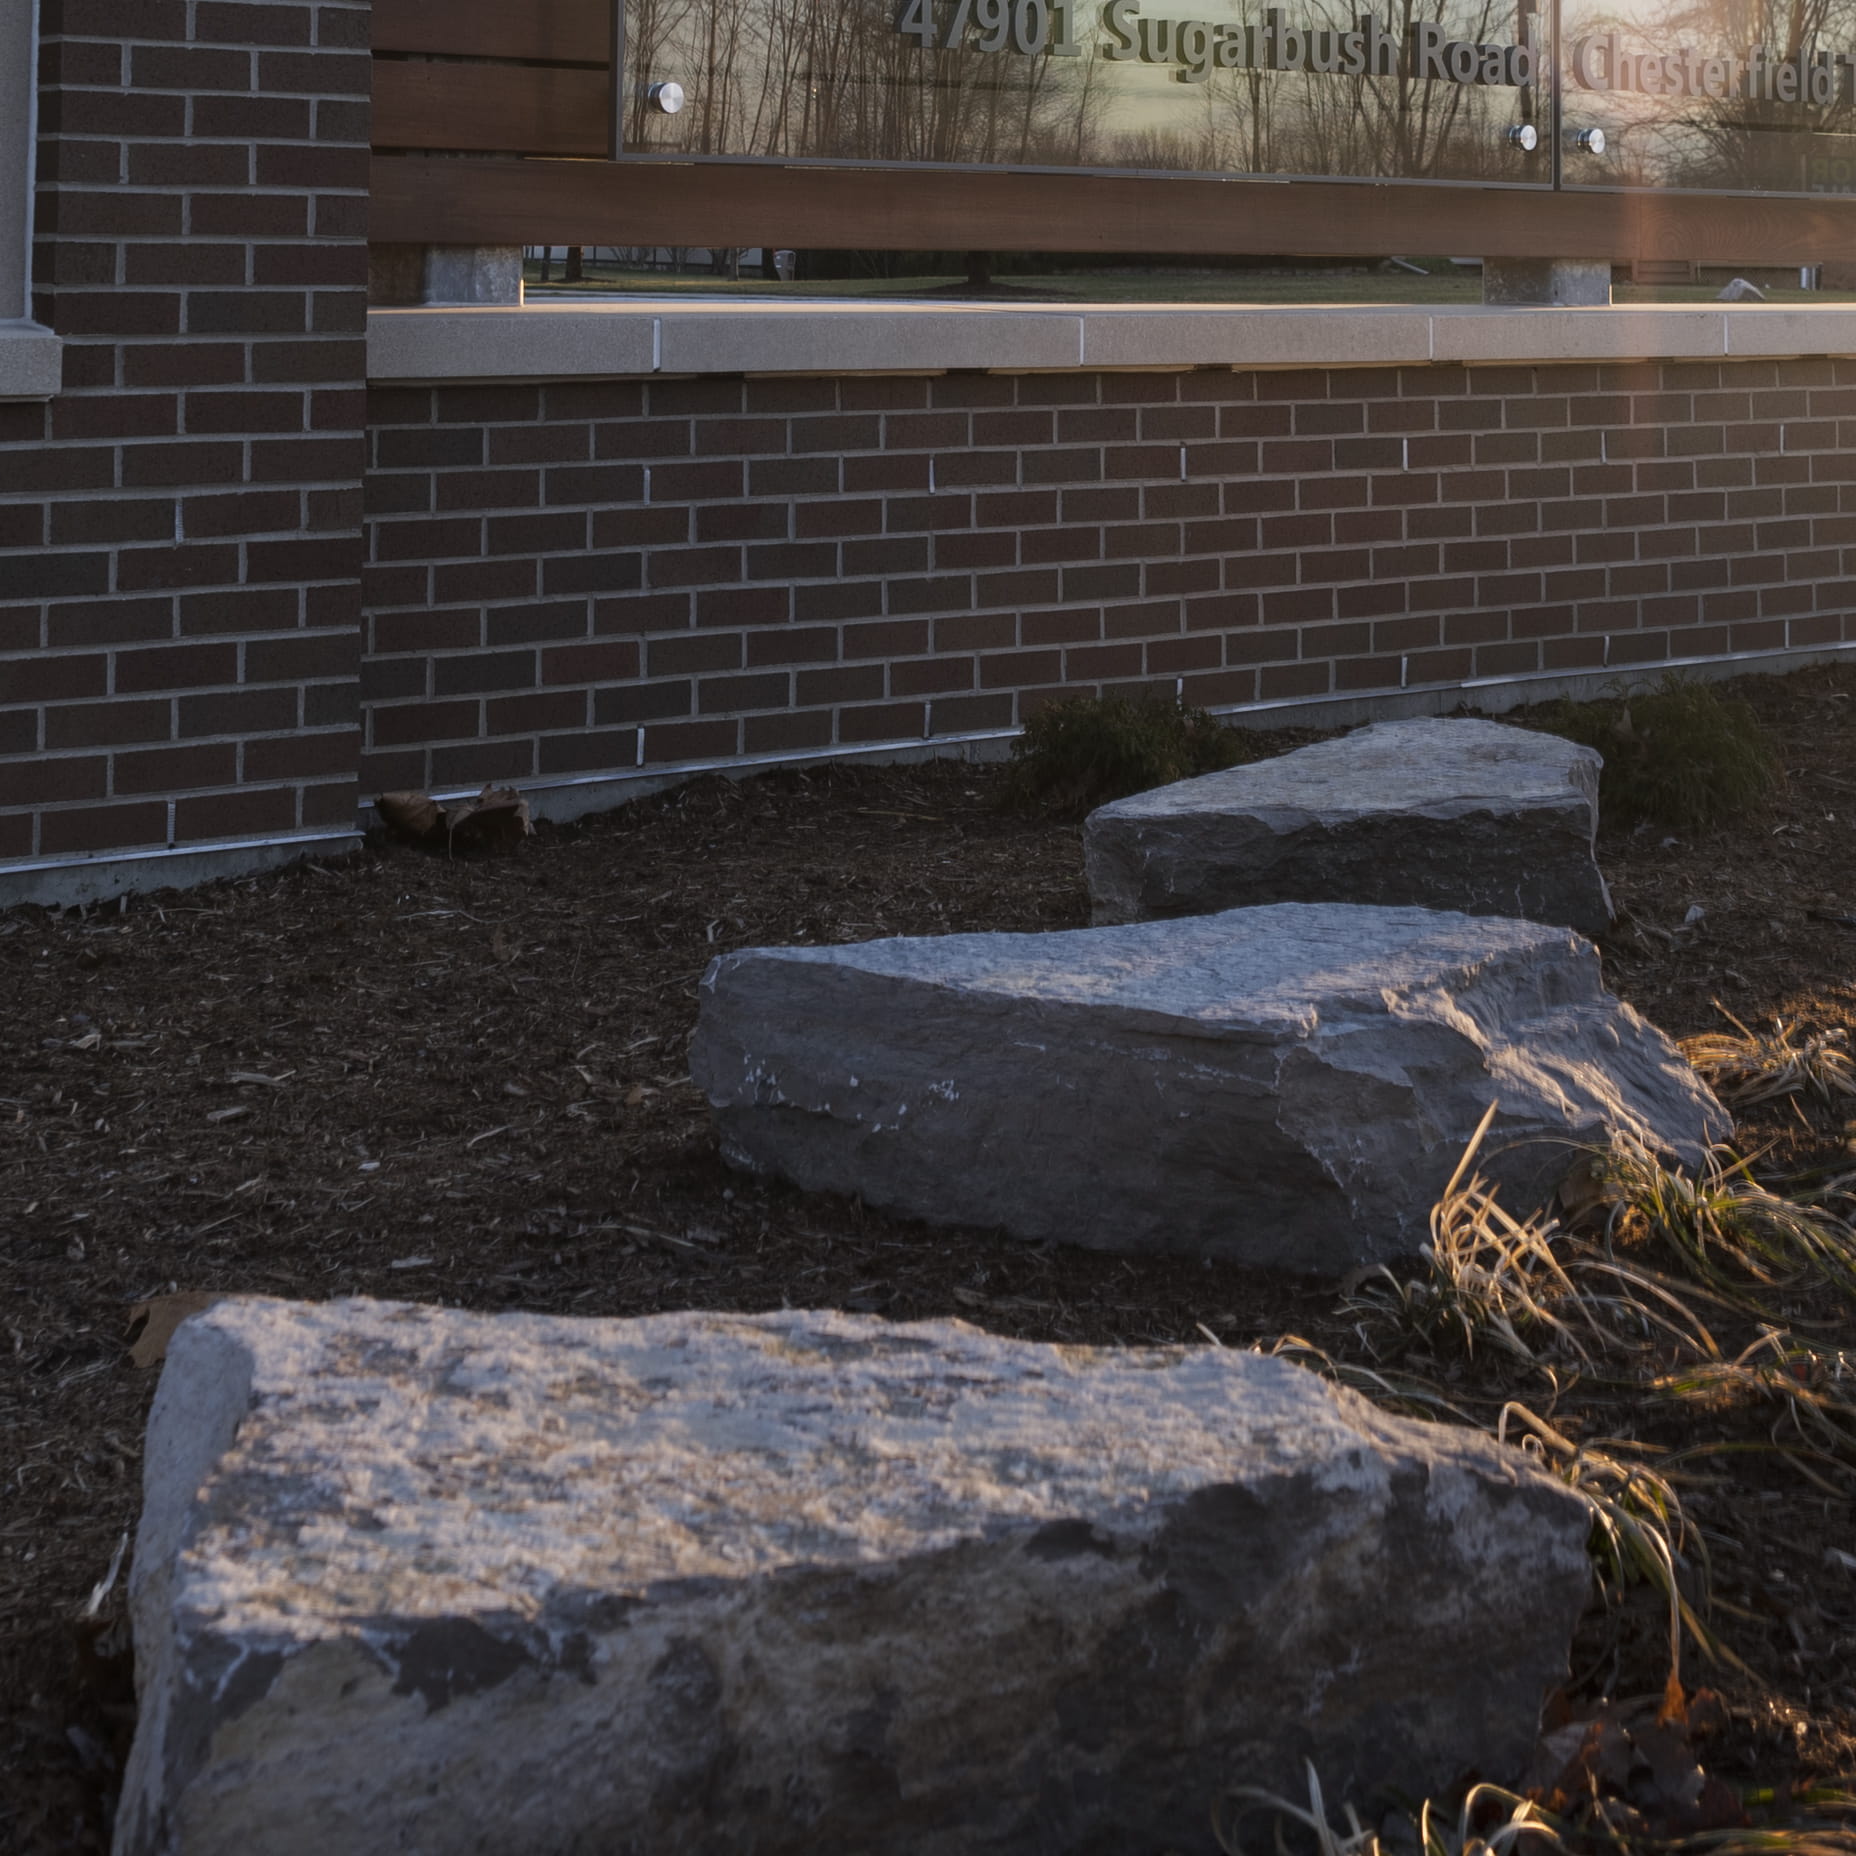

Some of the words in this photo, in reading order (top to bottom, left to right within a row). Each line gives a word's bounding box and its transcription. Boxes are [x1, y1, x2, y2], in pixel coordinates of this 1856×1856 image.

[1100, 0, 1399, 83] Sugarbush
[1412, 21, 1537, 86] Road
[1574, 31, 1834, 105] Chesterfield
